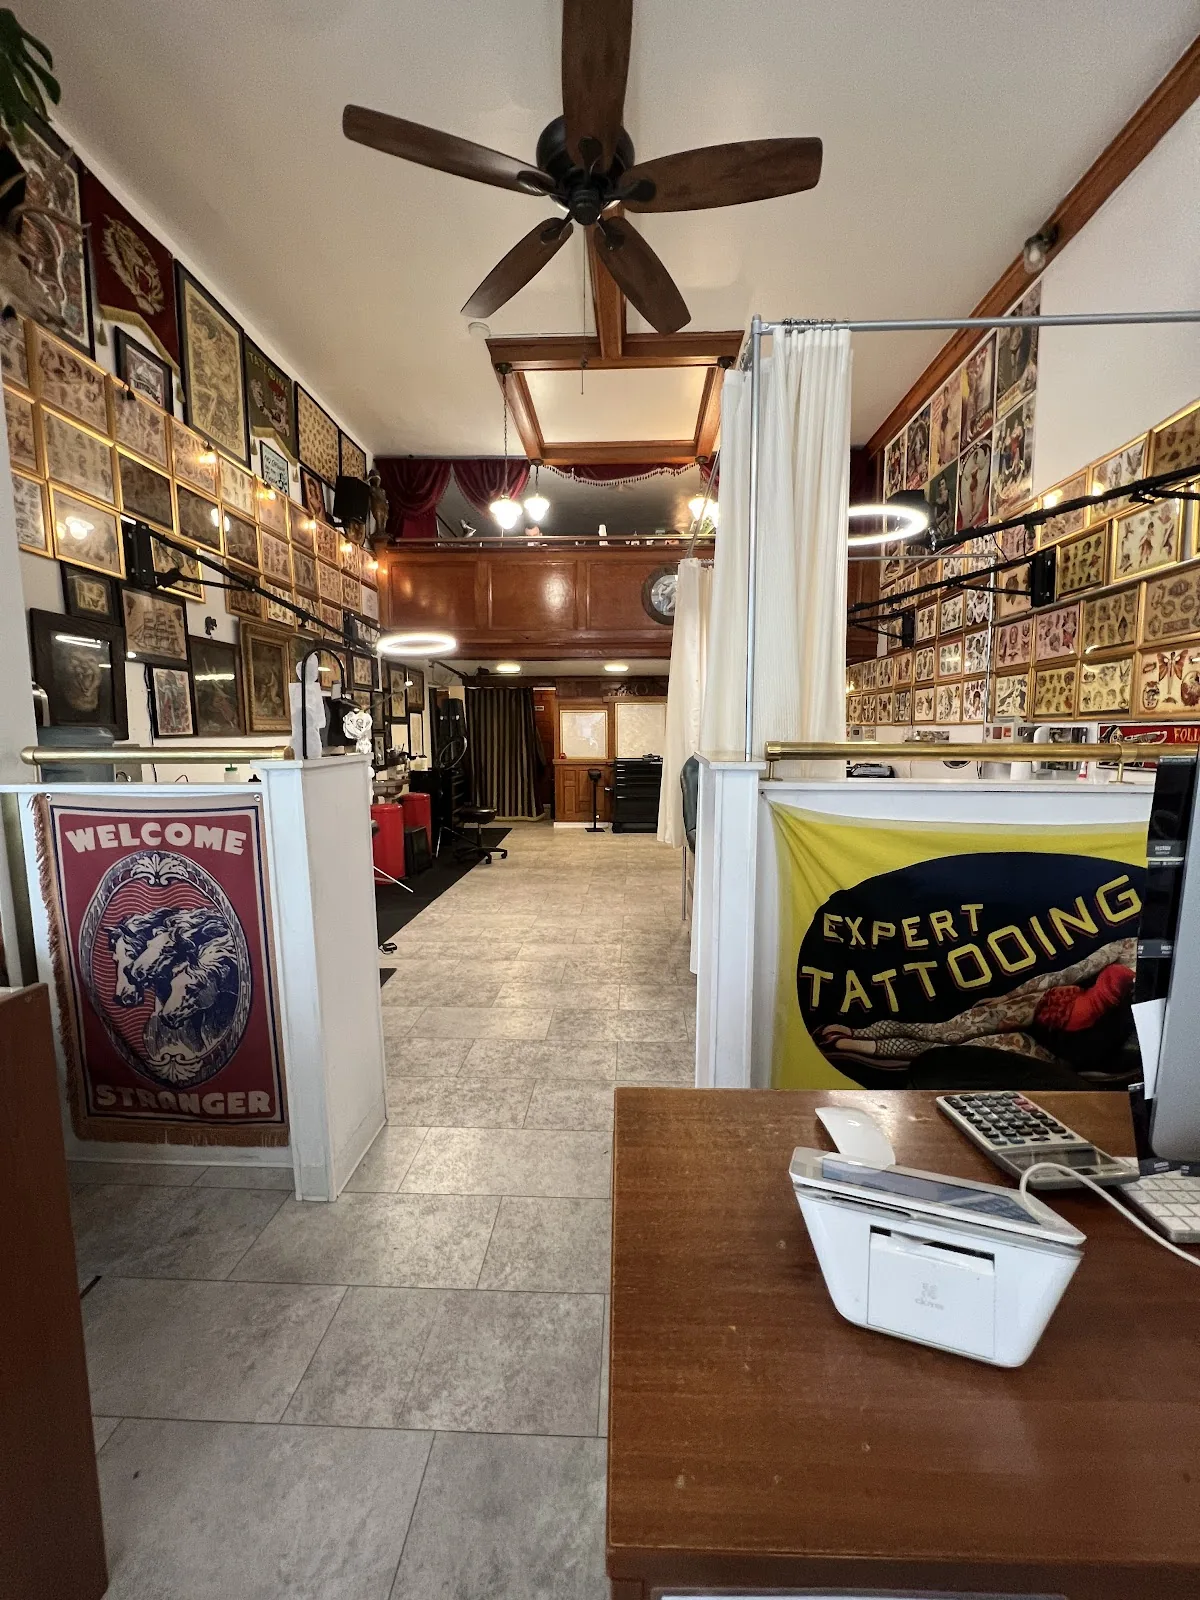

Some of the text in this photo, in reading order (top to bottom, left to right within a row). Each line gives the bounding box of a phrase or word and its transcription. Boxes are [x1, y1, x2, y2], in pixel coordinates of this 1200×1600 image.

[64, 822, 247, 855] WELCOME
[801, 874, 1142, 1014] TATTOOING
[823, 903, 984, 949] EXPERT
[94, 1084, 272, 1115] STRANGER
